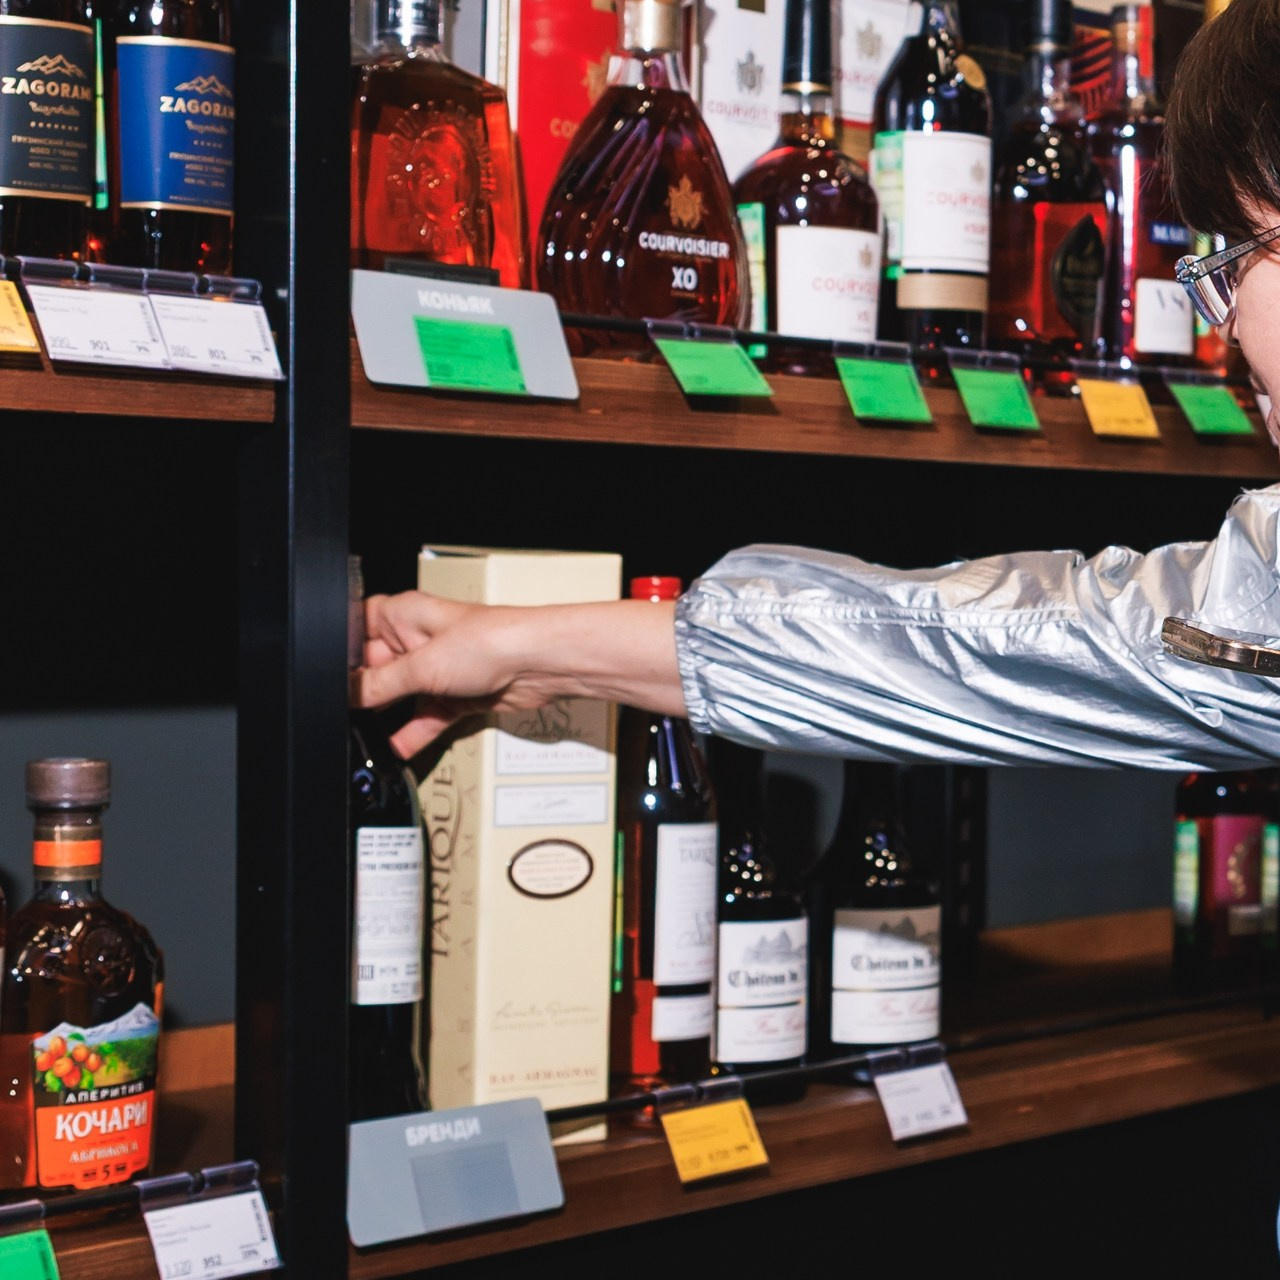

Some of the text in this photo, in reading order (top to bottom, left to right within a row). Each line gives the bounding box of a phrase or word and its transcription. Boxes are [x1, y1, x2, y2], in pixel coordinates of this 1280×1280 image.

[638, 232, 730, 258] COURVOISIER
[672, 266, 698, 291] XO
[417, 289, 494, 316] КОНЬЯК
[431, 762, 459, 957] TARIQUE
[55, 1099, 147, 1142] КОЧАРИ
[405, 1117, 481, 1147] БРЕНДИ
[102, 1164, 110, 1181] 5
